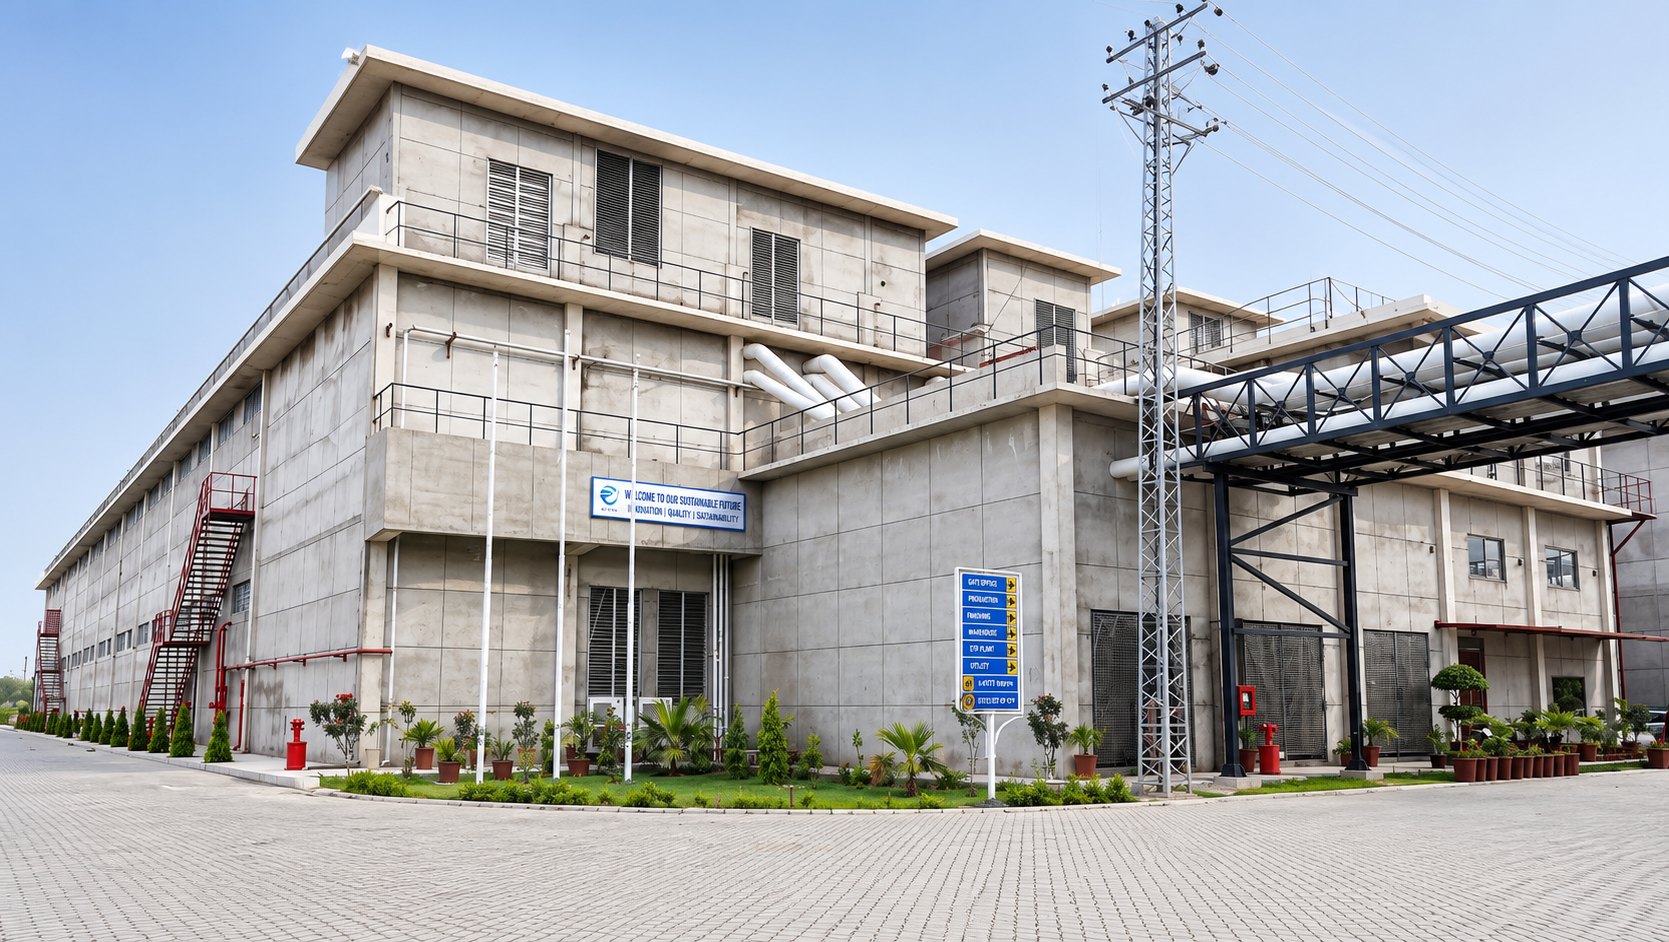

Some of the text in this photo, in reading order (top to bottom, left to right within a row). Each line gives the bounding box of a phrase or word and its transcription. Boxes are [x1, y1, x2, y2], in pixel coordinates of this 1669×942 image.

[624, 489, 656, 503] WLCOME
[657, 493, 665, 503] TO
[666, 494, 679, 504] OUR
